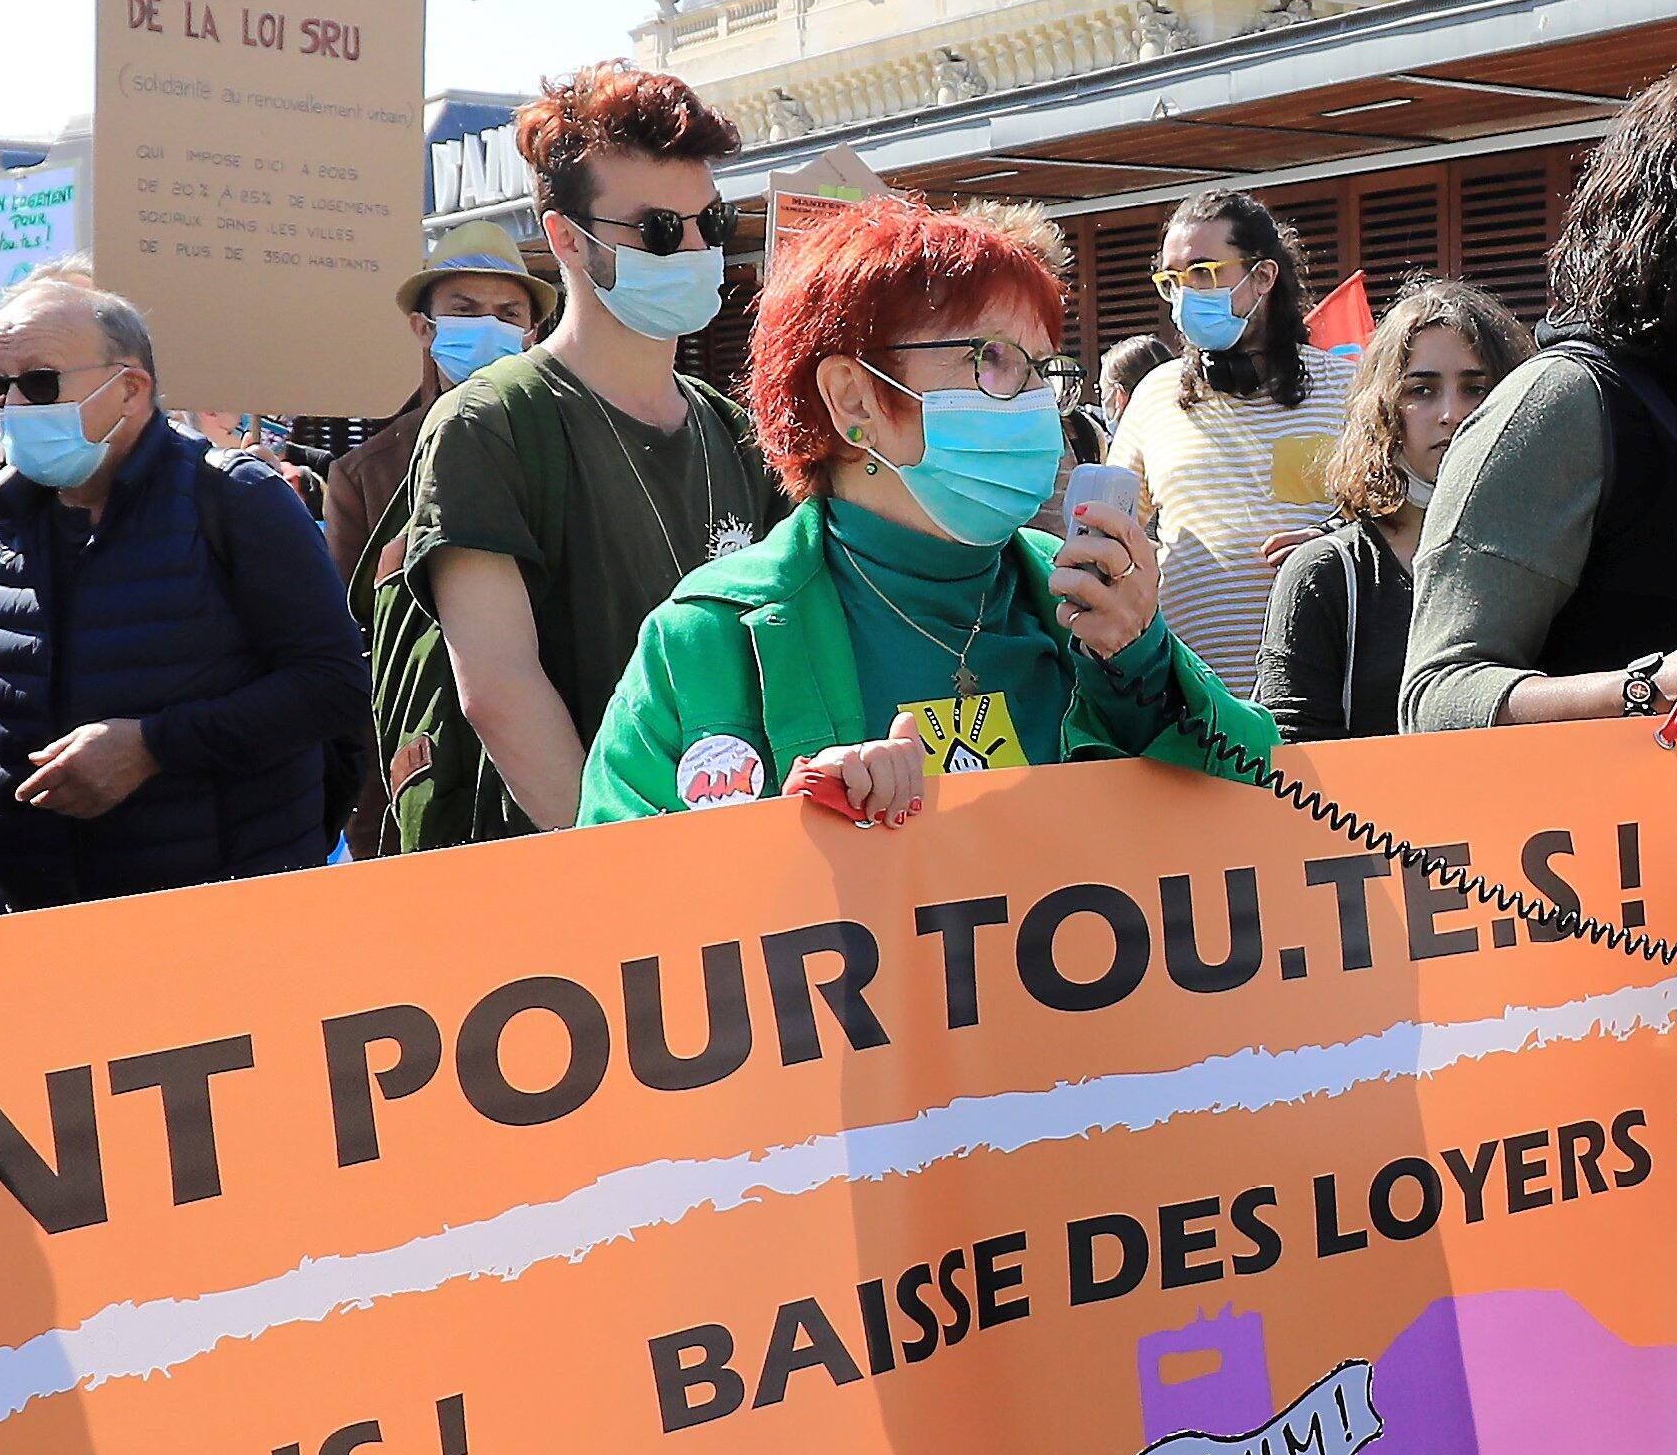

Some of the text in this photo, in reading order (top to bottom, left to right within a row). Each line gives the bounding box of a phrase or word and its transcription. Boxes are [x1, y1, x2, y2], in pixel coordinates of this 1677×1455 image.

[184, 0, 220, 42] LA
[242, 9, 285, 50] LOI
[300, 18, 361, 61] SRU
[137, 145, 164, 159] QUI
[186, 149, 243, 168] IMPOSE
[12, 185, 74, 211] LOGEMENT
[137, 178, 159, 193] DE
[288, 194, 305, 209] DE
[311, 198, 390, 216] LOGEMENTS
[10, 212, 46, 229] POUR
[138, 209, 354, 242] SOCIAUX DANS LES VILLES
[139, 239, 380, 272] DE PLUS DE 3500 HABITANTS
[322, 921, 891, 1167] POUR
[648, 1231, 1031, 1434] BAISSE
[1067, 1187, 1281, 1307] DES
[1314, 1110, 1652, 1258] LOYERS
